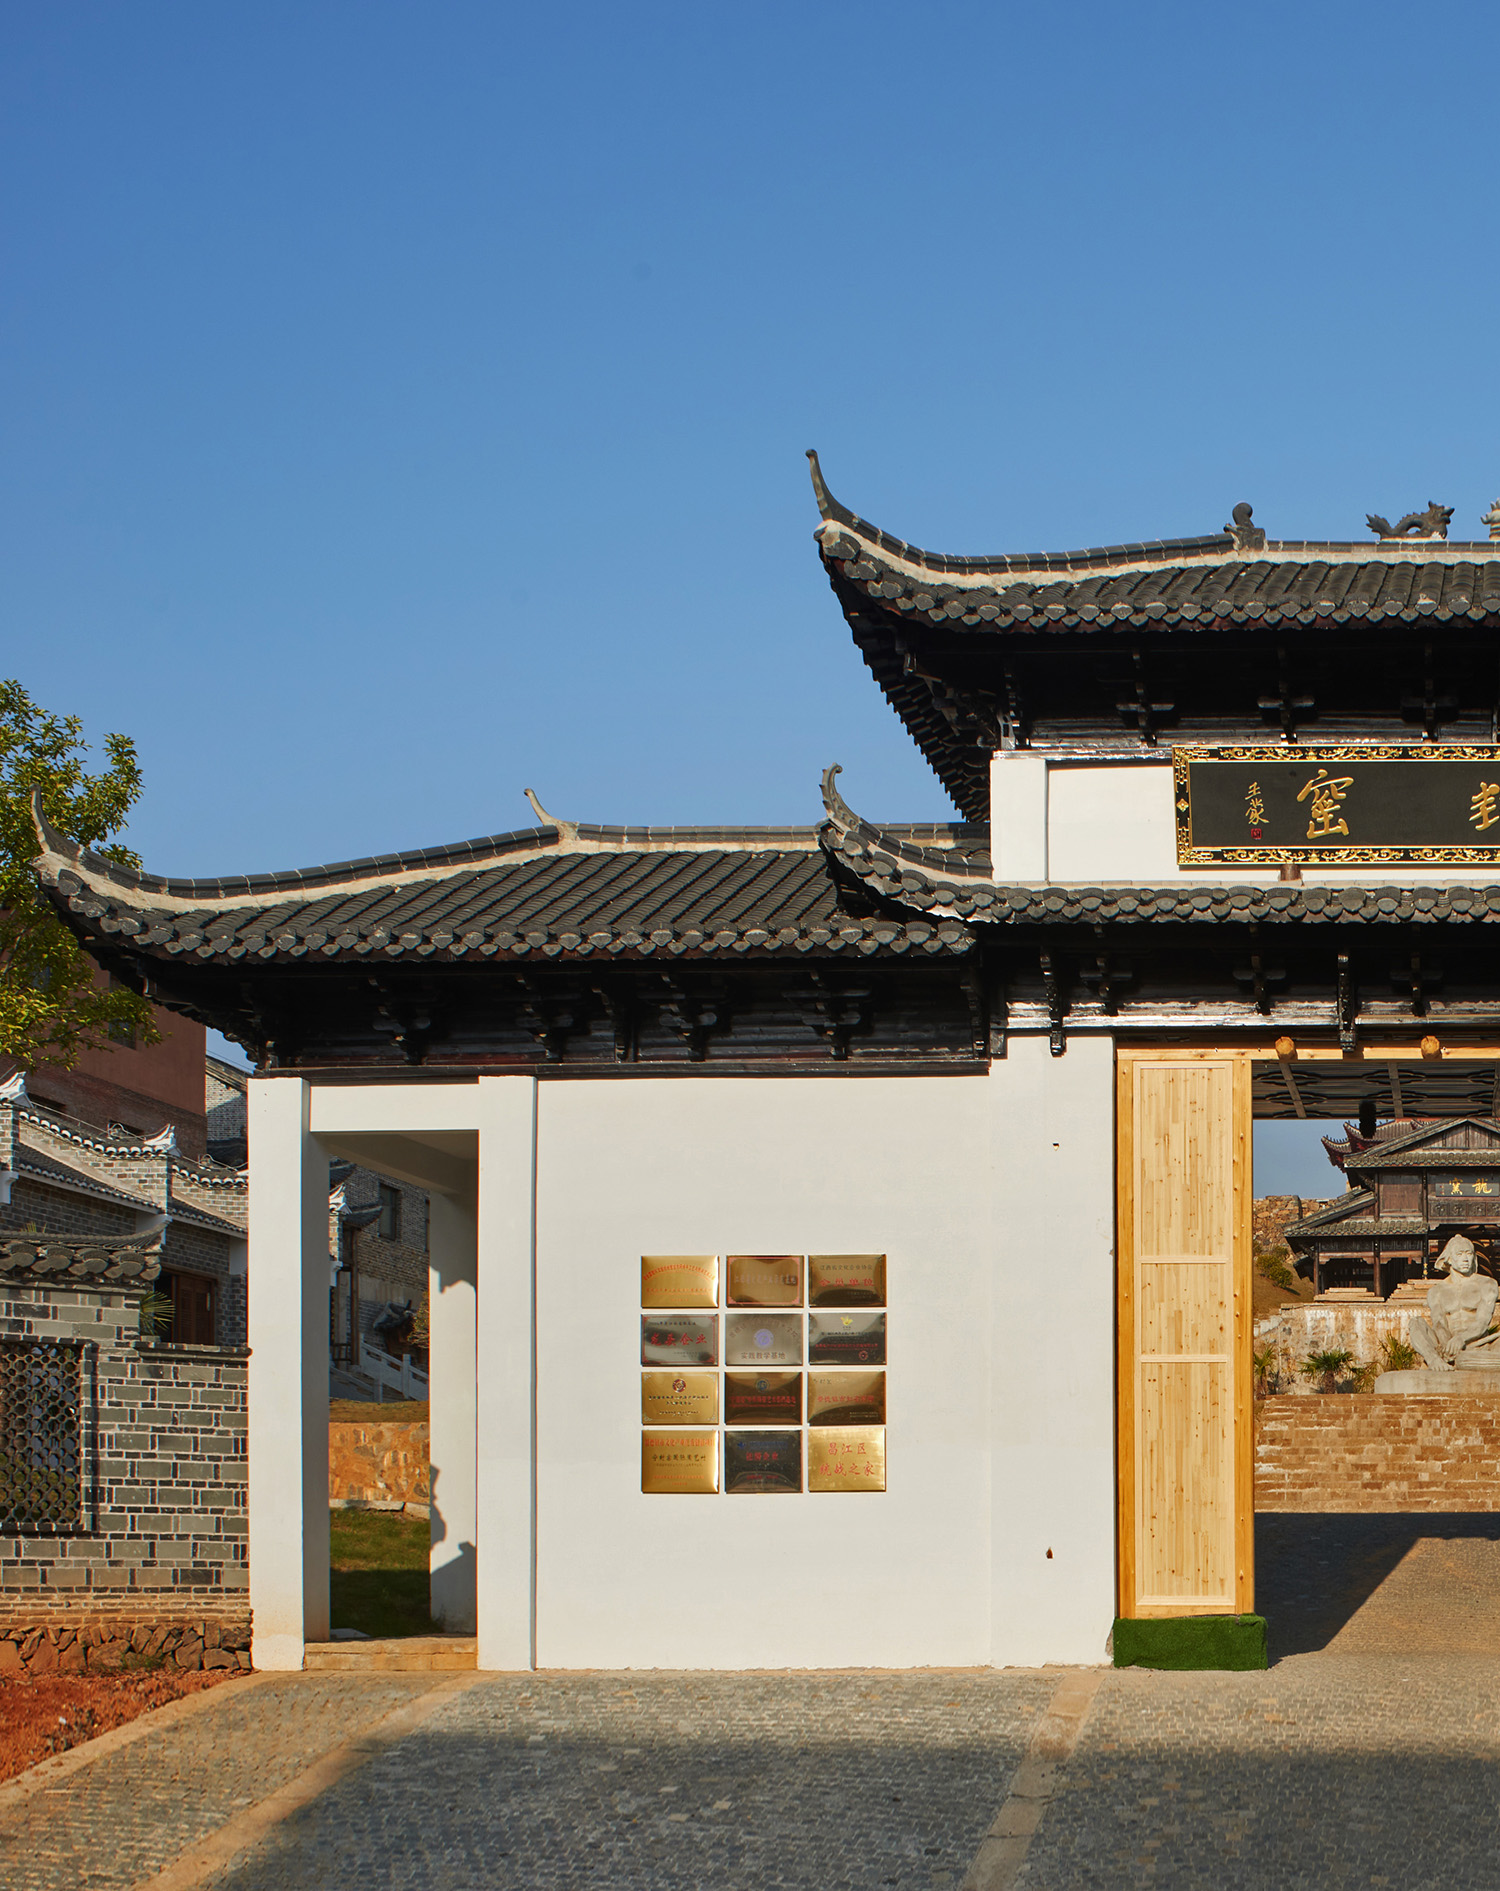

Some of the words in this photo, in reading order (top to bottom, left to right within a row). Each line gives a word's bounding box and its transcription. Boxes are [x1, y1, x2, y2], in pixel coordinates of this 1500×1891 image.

[650, 1332, 707, 1346] 龙头企业
[741, 1352, 786, 1360] 实践教学基地
[828, 1442, 866, 1456] 昌江区
[819, 1461, 875, 1477] 统战之家
